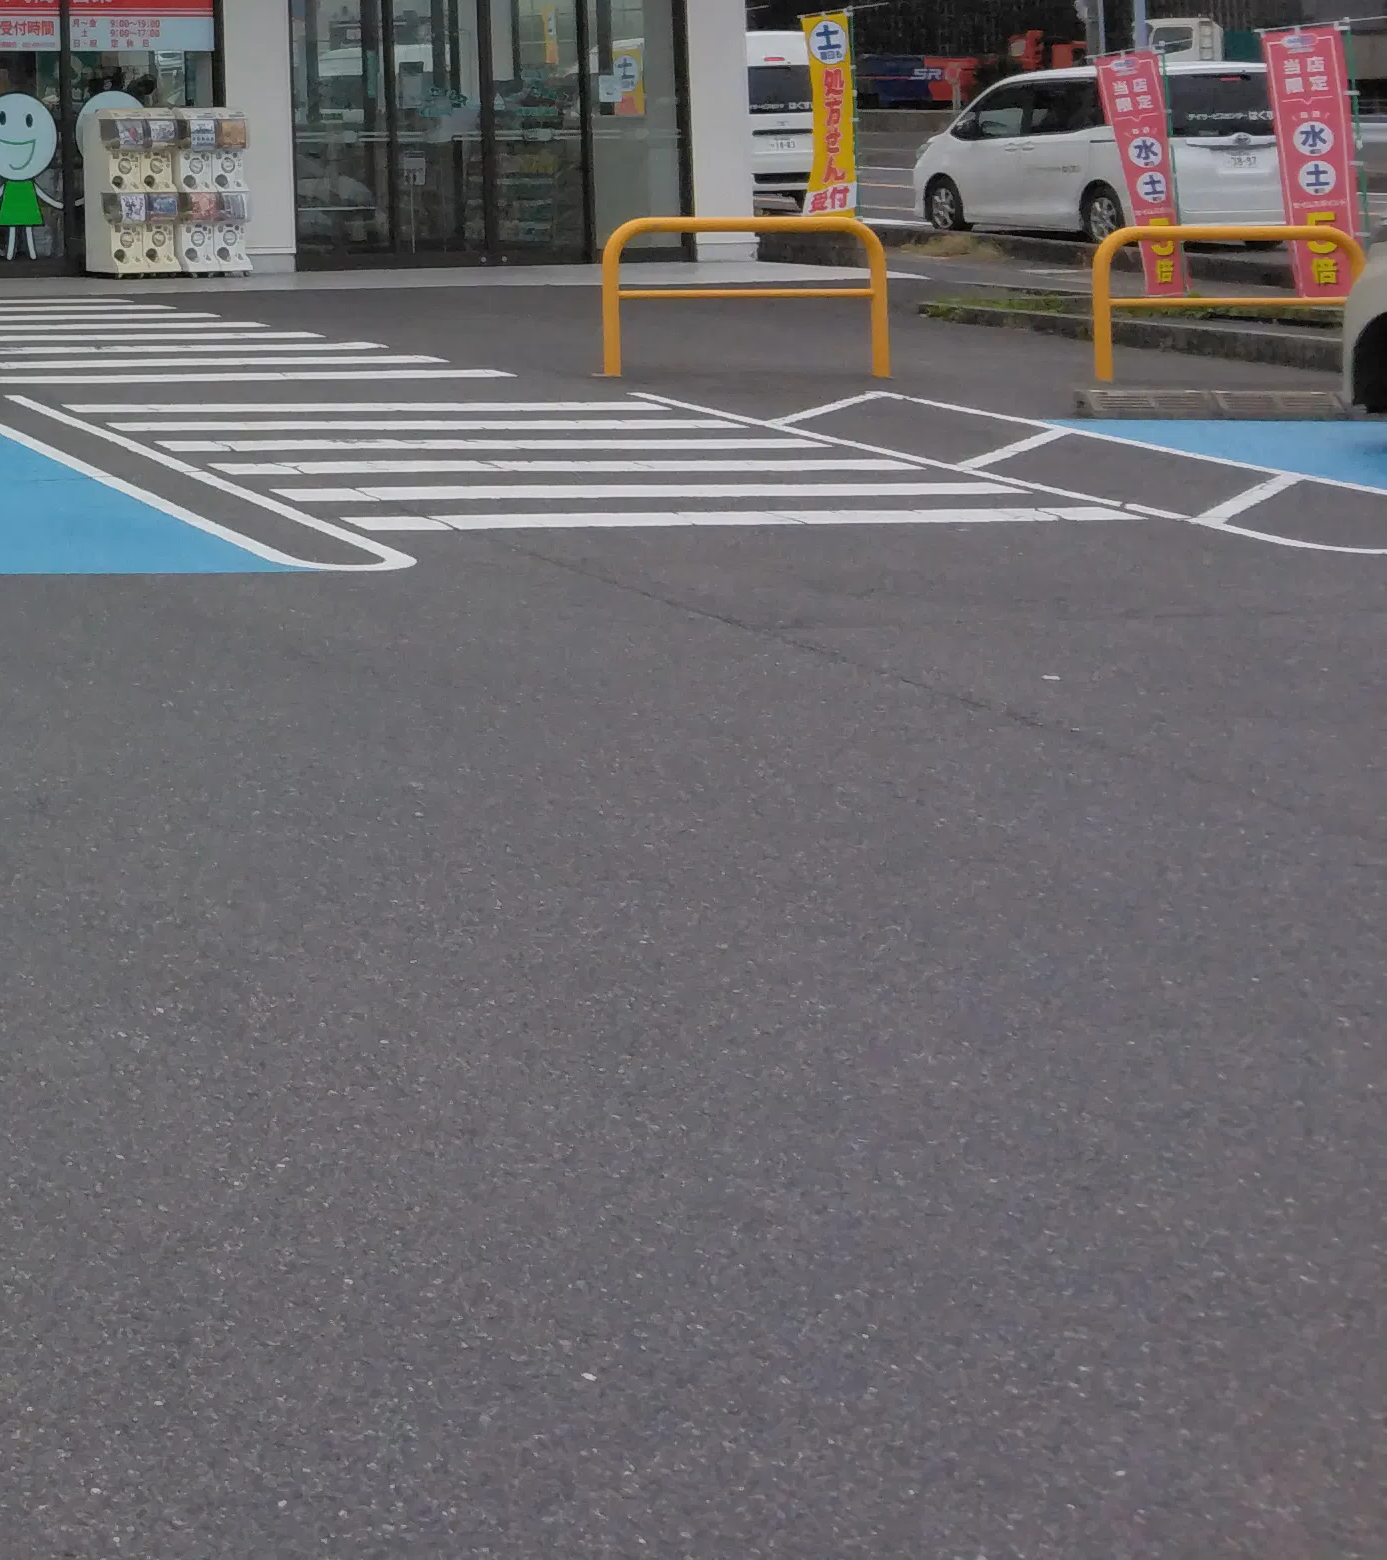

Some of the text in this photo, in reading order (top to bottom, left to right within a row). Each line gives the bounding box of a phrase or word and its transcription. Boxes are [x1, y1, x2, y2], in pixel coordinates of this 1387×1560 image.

[816, 25, 842, 50] 土
[1300, 124, 1327, 148] 水
[1133, 142, 1158, 161] 水
[1306, 163, 1330, 187] 土
